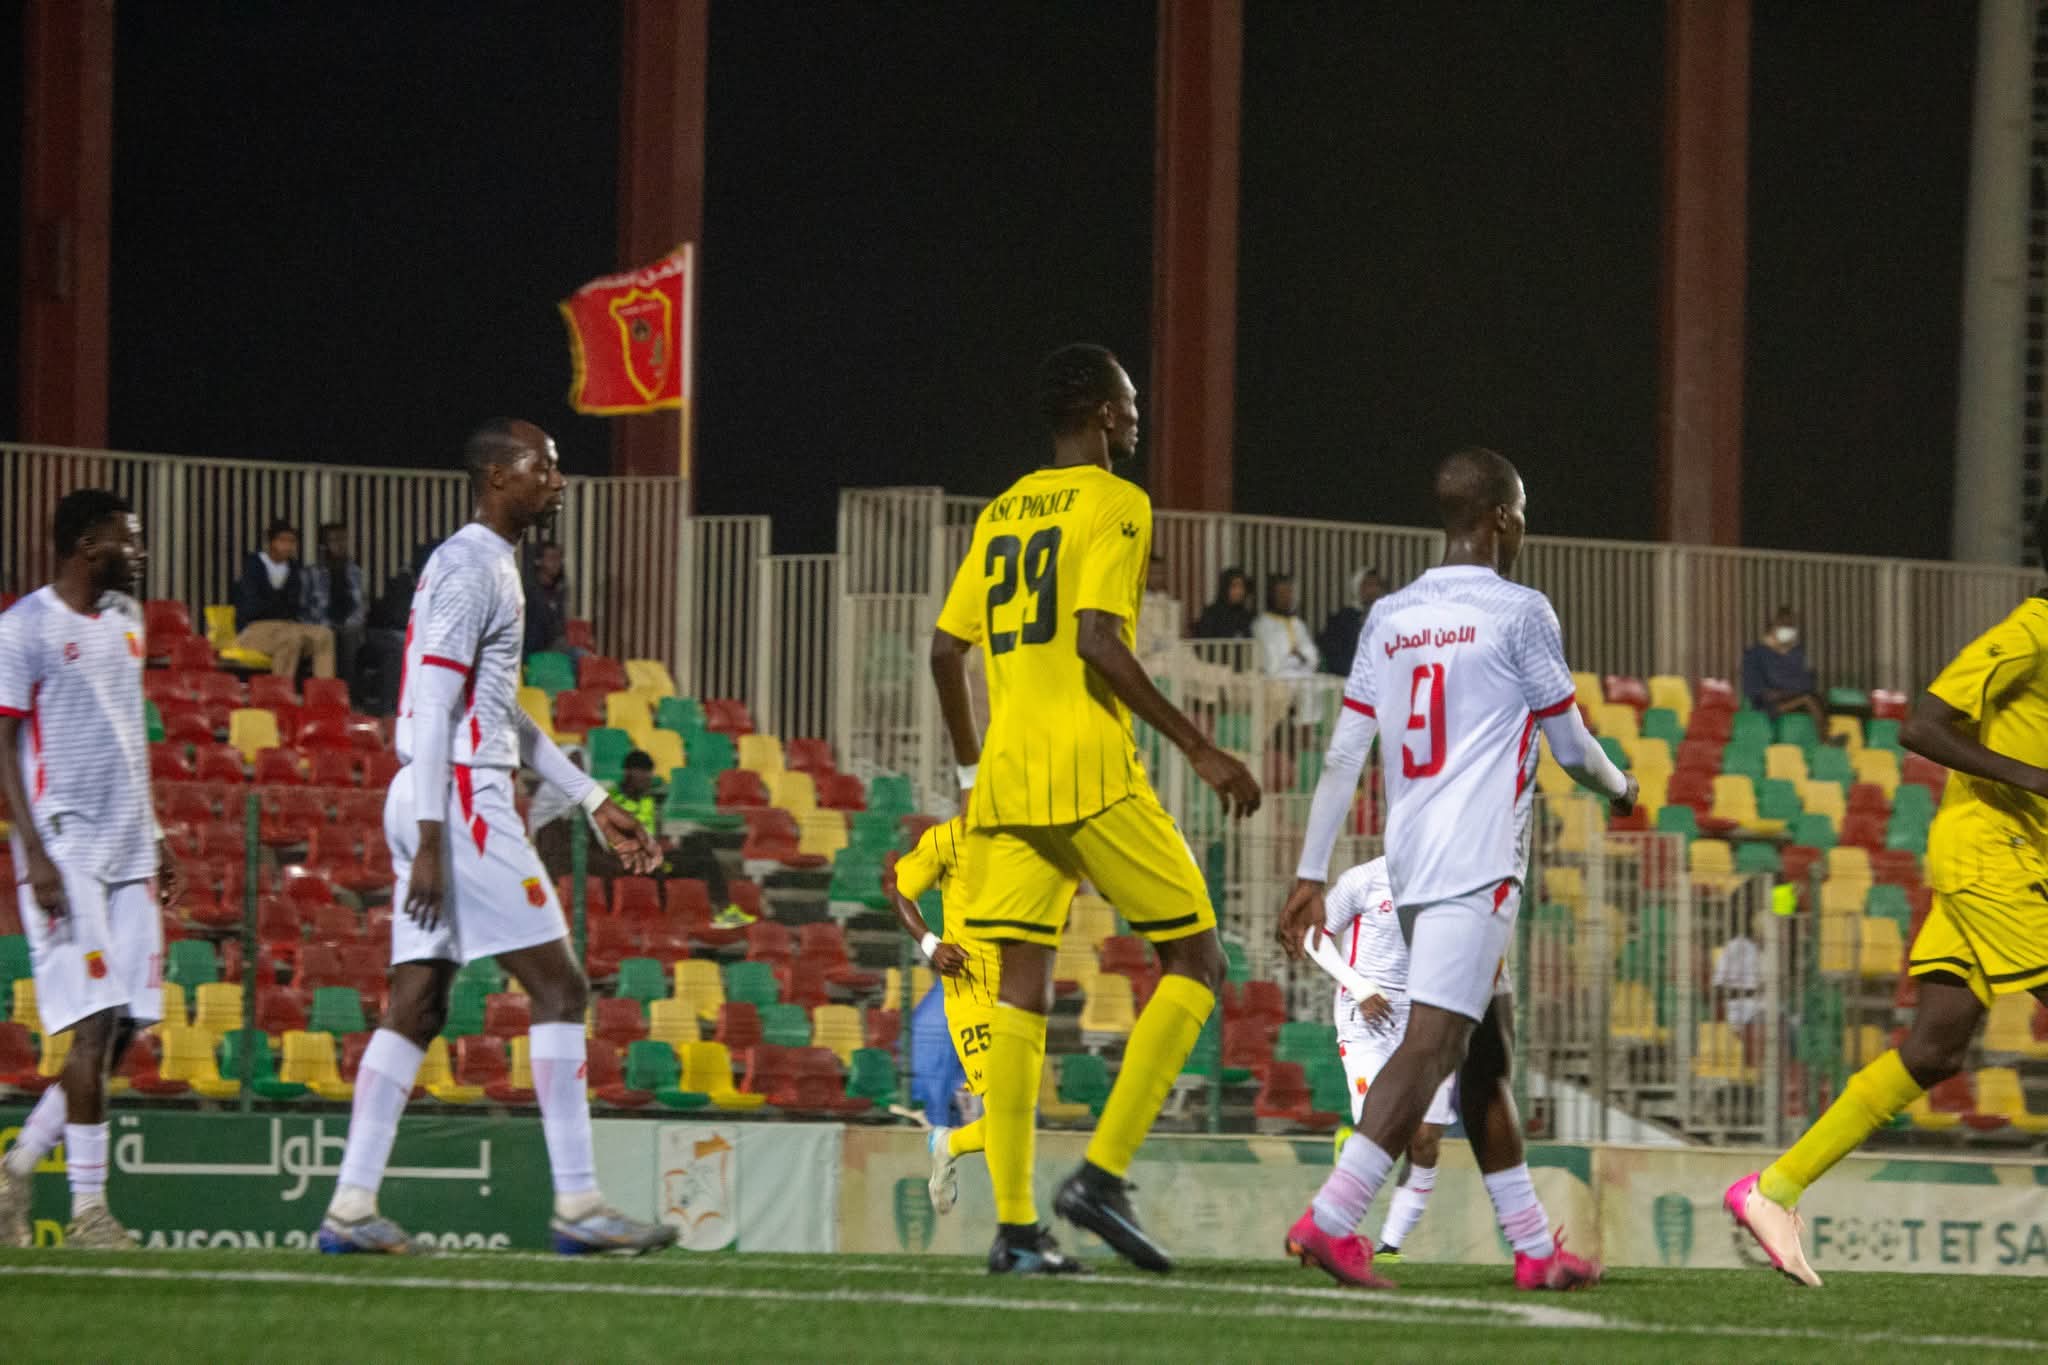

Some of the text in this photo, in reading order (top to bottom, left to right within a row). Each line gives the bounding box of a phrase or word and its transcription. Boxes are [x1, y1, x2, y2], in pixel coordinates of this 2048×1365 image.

[984, 525, 1062, 656] 29
[1402, 663, 1447, 780] 9
[960, 1023, 992, 1057] 25
[1940, 1219, 1983, 1264] ET
